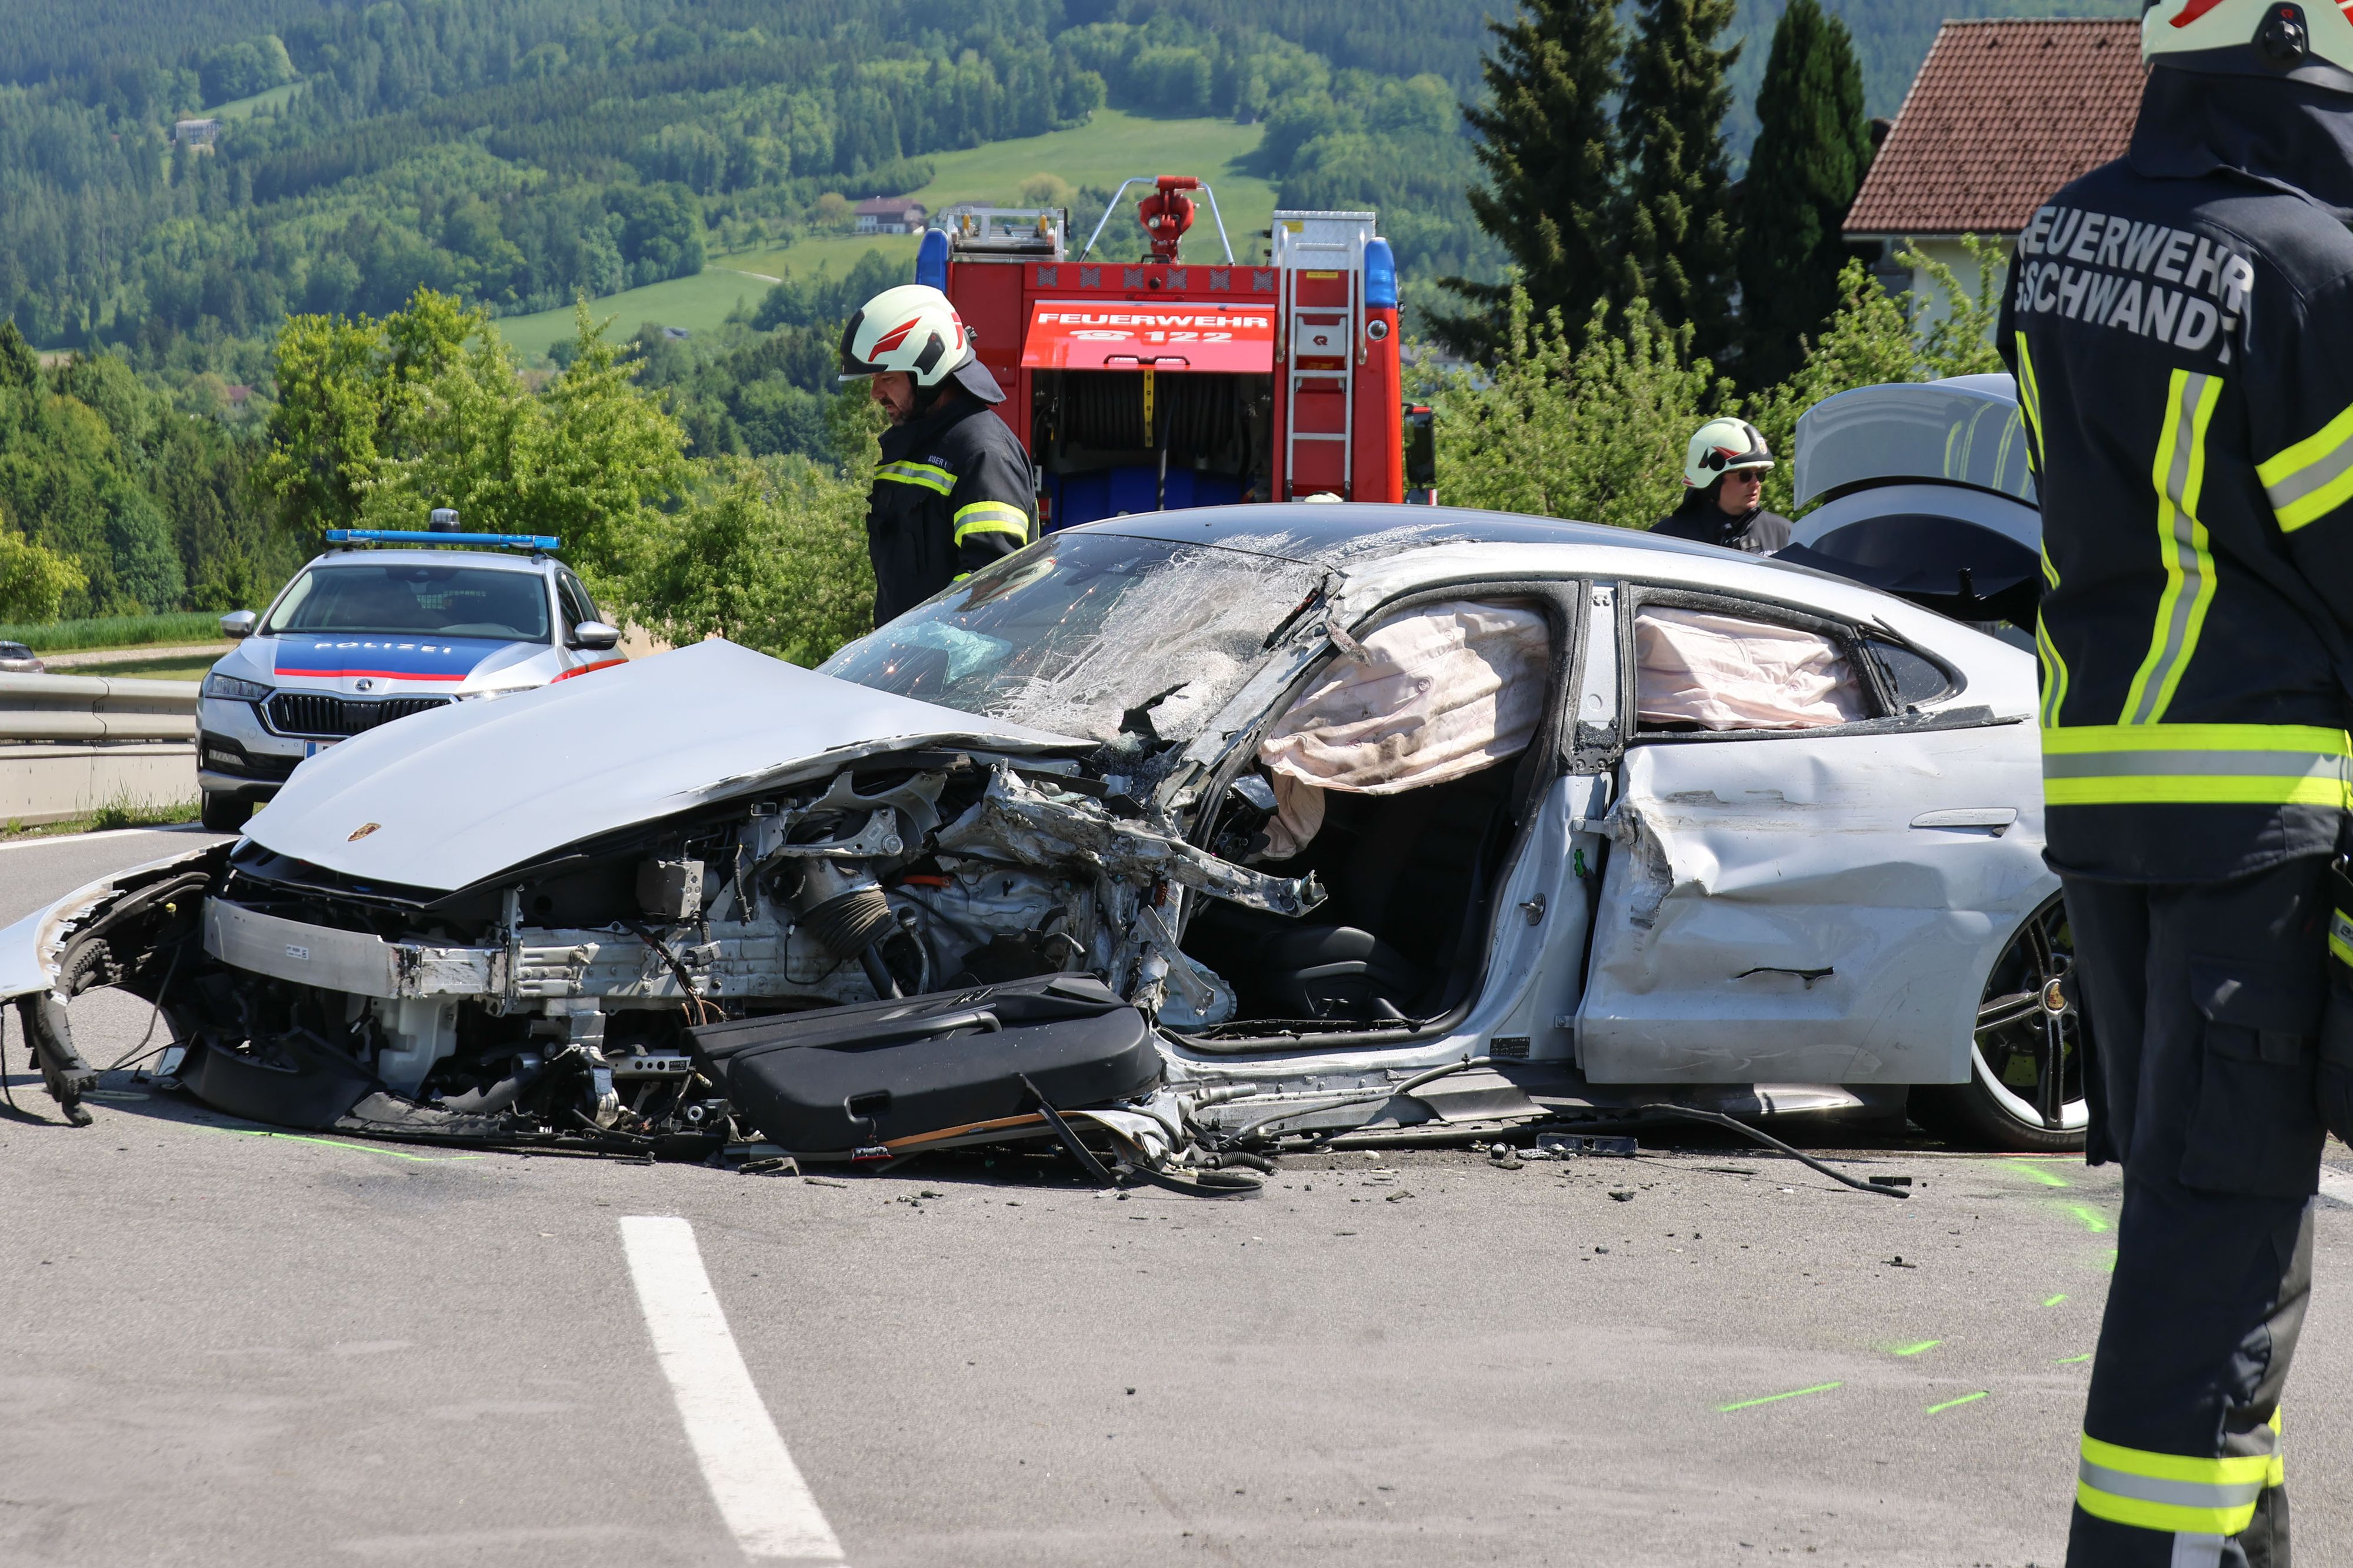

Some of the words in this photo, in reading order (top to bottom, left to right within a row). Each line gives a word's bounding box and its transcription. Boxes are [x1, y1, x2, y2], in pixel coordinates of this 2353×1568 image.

[1038, 313, 1268, 327] FEUERWEHR
[1144, 330, 1232, 342] 122
[314, 642, 452, 653] POLIZEI
